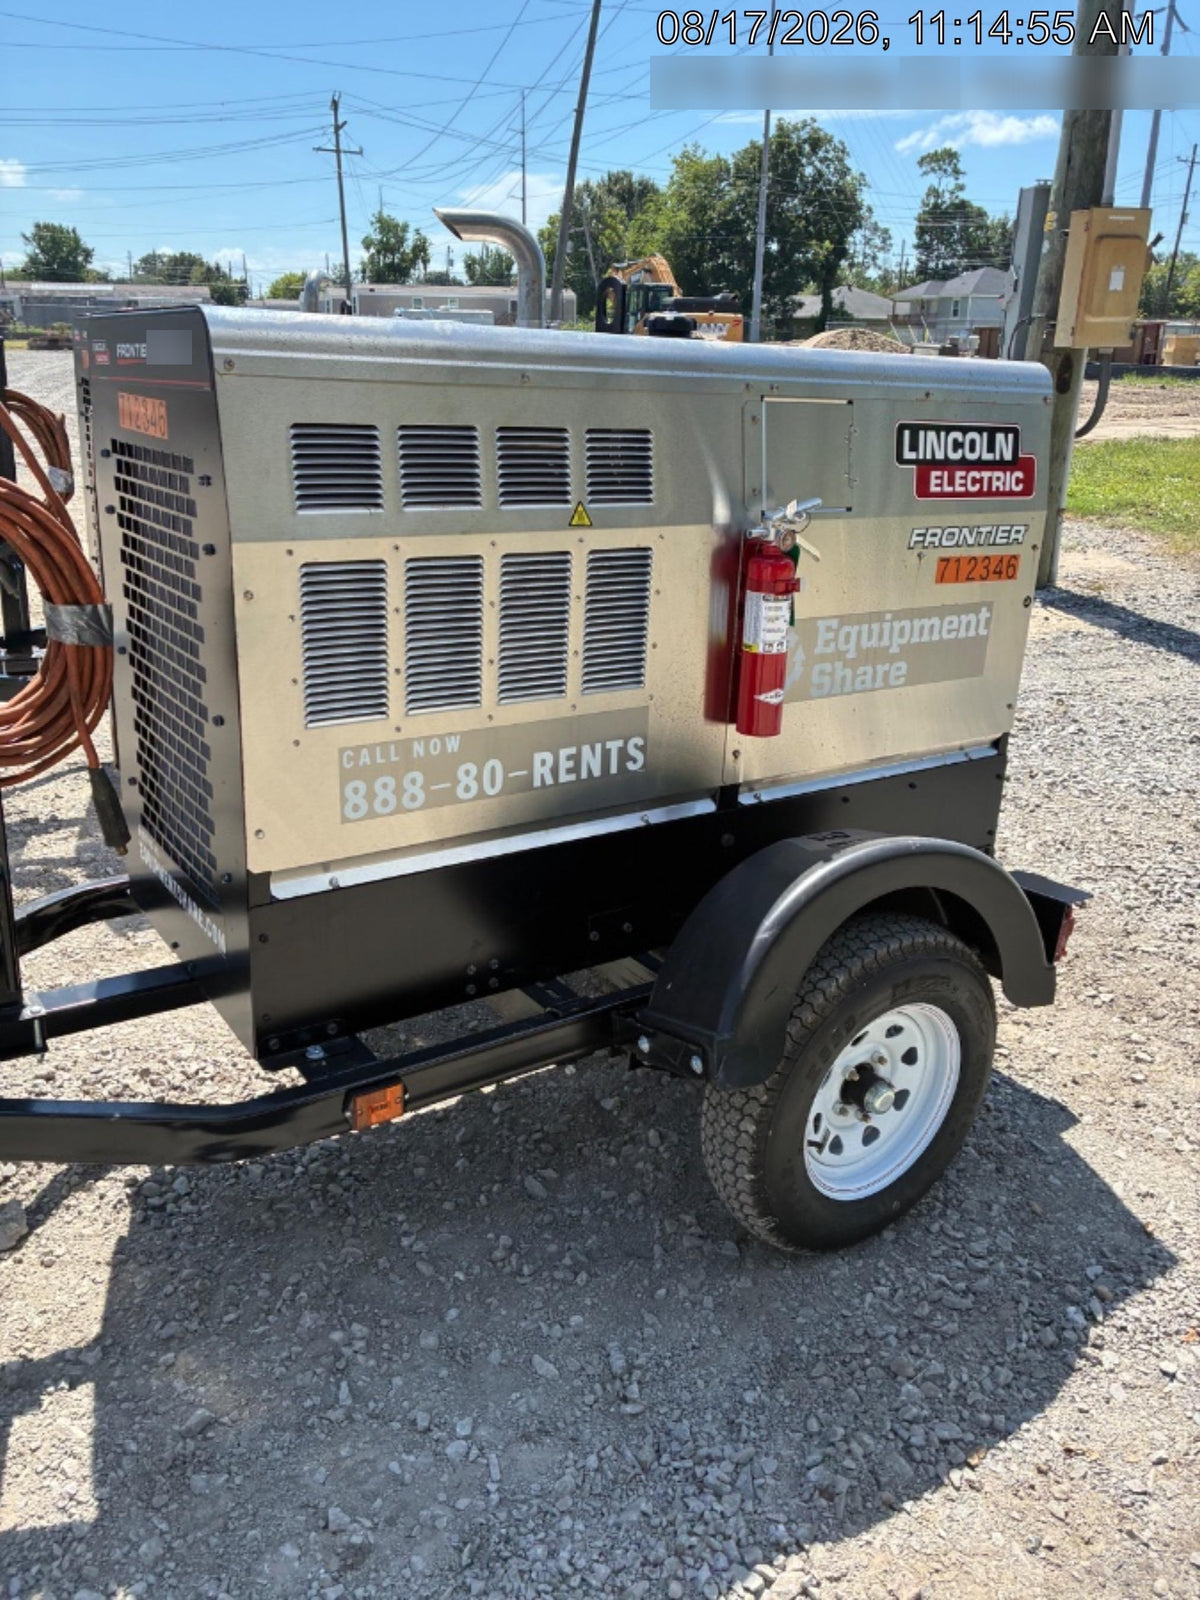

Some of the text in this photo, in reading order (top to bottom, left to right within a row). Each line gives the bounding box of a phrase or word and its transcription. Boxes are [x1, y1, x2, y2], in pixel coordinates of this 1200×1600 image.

[116, 343, 147, 358] FRONTIE
[119, 393, 167, 438] 712346
[902, 429, 1014, 461] LINCOLN
[929, 471, 1024, 493] ELECTRIC
[907, 524, 1029, 549] FRONTIER
[938, 555, 1019, 582] 712346
[813, 606, 991, 659] Equipment
[809, 660, 908, 697] Share
[342, 735, 462, 769] CALL NOW
[343, 736, 645, 821] 888-80-RENTS
